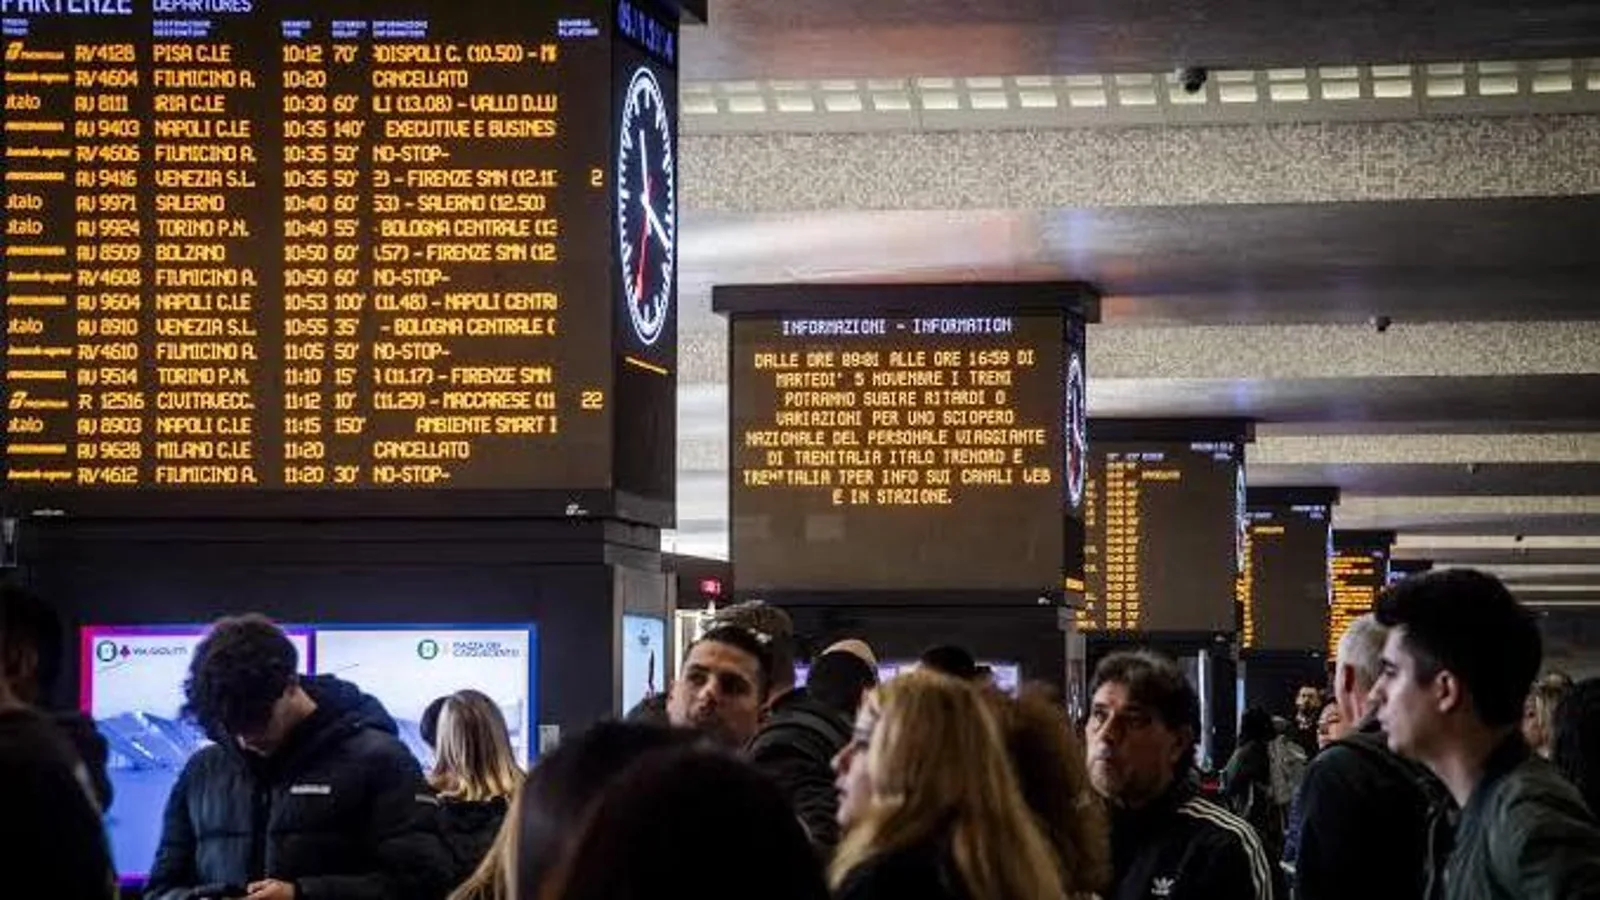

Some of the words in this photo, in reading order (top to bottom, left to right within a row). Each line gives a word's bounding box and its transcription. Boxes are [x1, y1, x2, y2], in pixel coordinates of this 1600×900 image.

[152, 0, 252, 12] DEPARTURES
[153, 44, 193, 63] PISA
[196, 44, 230, 63] C.LE
[283, 44, 322, 63] 10:12
[446, 44, 461, 63] C.
[154, 69, 236, 88] FIUMICINO
[283, 69, 326, 88] 10:20
[373, 69, 468, 88] CANCELLATO
[190, 94, 225, 113] C.LE
[283, 94, 327, 113] 10:30
[470, 94, 519, 113] VALLO
[521, 94, 557, 113] D.LU
[155, 119, 211, 138] NAPOLI
[215, 119, 250, 138] C.LE
[284, 119, 327, 138] 10:35
[473, 119, 485, 138] E
[488, 119, 556, 138] BUSINES
[155, 144, 237, 163] FIUMICINO
[284, 144, 328, 163] 10:35
[283, 169, 328, 188] 10:35
[407, 169, 473, 188] FIRENZE
[476, 169, 508, 188] SMN
[590, 169, 603, 187] 2
[156, 193, 225, 213] SALERNO
[284, 193, 328, 213] 10:40
[417, 193, 486, 213] SALERNO
[156, 218, 215, 238] TORINO
[217, 218, 249, 238] P.N.
[284, 218, 328, 238] 10:40
[380, 218, 451, 238] BOLOGNA
[453, 218, 531, 238] CENTRALE
[155, 242, 226, 262] BOLZANO
[284, 242, 328, 262] 10:50
[426, 242, 492, 262] FIRENZE
[495, 242, 527, 262] SMN
[155, 268, 238, 287] FIUMICINO
[283, 268, 329, 287] 10:50
[156, 292, 212, 311] NAPOLI
[216, 292, 251, 311] C.LE
[284, 292, 328, 311] 10:53
[444, 292, 501, 311] NAPOLI
[284, 317, 329, 337] 10:55
[393, 317, 464, 337] BOLOGNA
[466, 317, 544, 337] CENTRALE
[782, 318, 886, 335] INFORMAZIONI
[913, 317, 1013, 333] INFORMATION
[156, 341, 239, 361] FIUMICINO
[284, 341, 325, 361] 11:05
[754, 353, 799, 368] DALLE
[806, 352, 835, 367] ORE
[889, 351, 926, 367] ALLE
[934, 351, 961, 366] ORE
[1016, 350, 1035, 365] DI
[156, 366, 215, 386] TORINO
[218, 366, 250, 386] P.N.
[284, 366, 322, 386] 11:10
[450, 366, 517, 386] FIRENZE
[519, 366, 552, 386] SMN
[872, 370, 944, 386] NOVEMBRE
[969, 370, 1012, 386] TRENI
[78, 391, 93, 410] R
[156, 391, 255, 410] CIVITAVECC.
[284, 391, 321, 410] 11:12
[443, 391, 532, 410] MACCARESE
[581, 391, 604, 410] 22
[784, 391, 856, 407] POTRANNO
[863, 391, 917, 407] SUBIRE
[924, 390, 986, 405] RITARDI
[156, 415, 213, 435] NAPOLI
[216, 415, 252, 435] C.LE
[284, 415, 321, 435] 11:15
[415, 415, 492, 435] AMBIENTE
[495, 415, 546, 435] SMART
[872, 410, 900, 426] PER
[908, 410, 936, 426] UNO
[943, 410, 1014, 425] SCIOPERO
[745, 430, 826, 447] NAZIONALE
[832, 430, 860, 446] DEL
[867, 429, 948, 446] PERSONALE
[156, 440, 213, 459] MILANO
[216, 440, 252, 459] C.LE
[284, 440, 325, 459] 11:20
[373, 440, 470, 459] CANCELLATO
[766, 450, 784, 466] DI
[795, 450, 882, 465] TRENITALIA
[889, 449, 935, 464] ITALO
[156, 464, 238, 483] FIUMICINO
[284, 464, 324, 483] 11:20
[838, 469, 874, 485] TPER
[881, 469, 919, 485] INFO
[926, 468, 950, 484] SUI
[960, 468, 1013, 484] CANALI
[851, 488, 870, 505] IN
[877, 488, 953, 505] STAZIONE.
